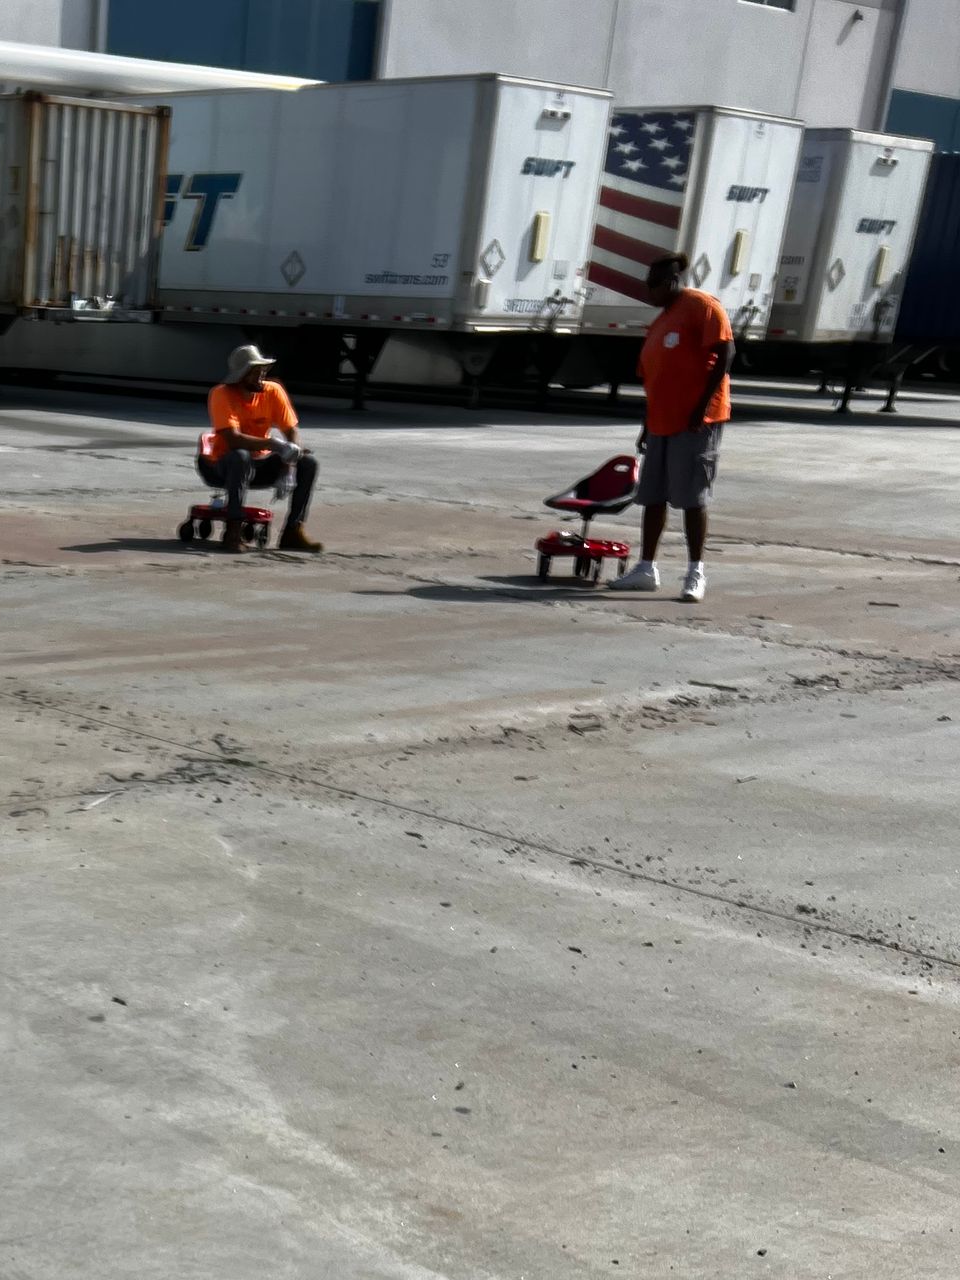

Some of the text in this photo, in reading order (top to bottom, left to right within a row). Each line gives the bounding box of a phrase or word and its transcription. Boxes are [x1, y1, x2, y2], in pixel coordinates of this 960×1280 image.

[520, 156, 576, 179] SWIFT
[726, 184, 770, 204] SWIFT
[855, 217, 897, 236] SWIFT
